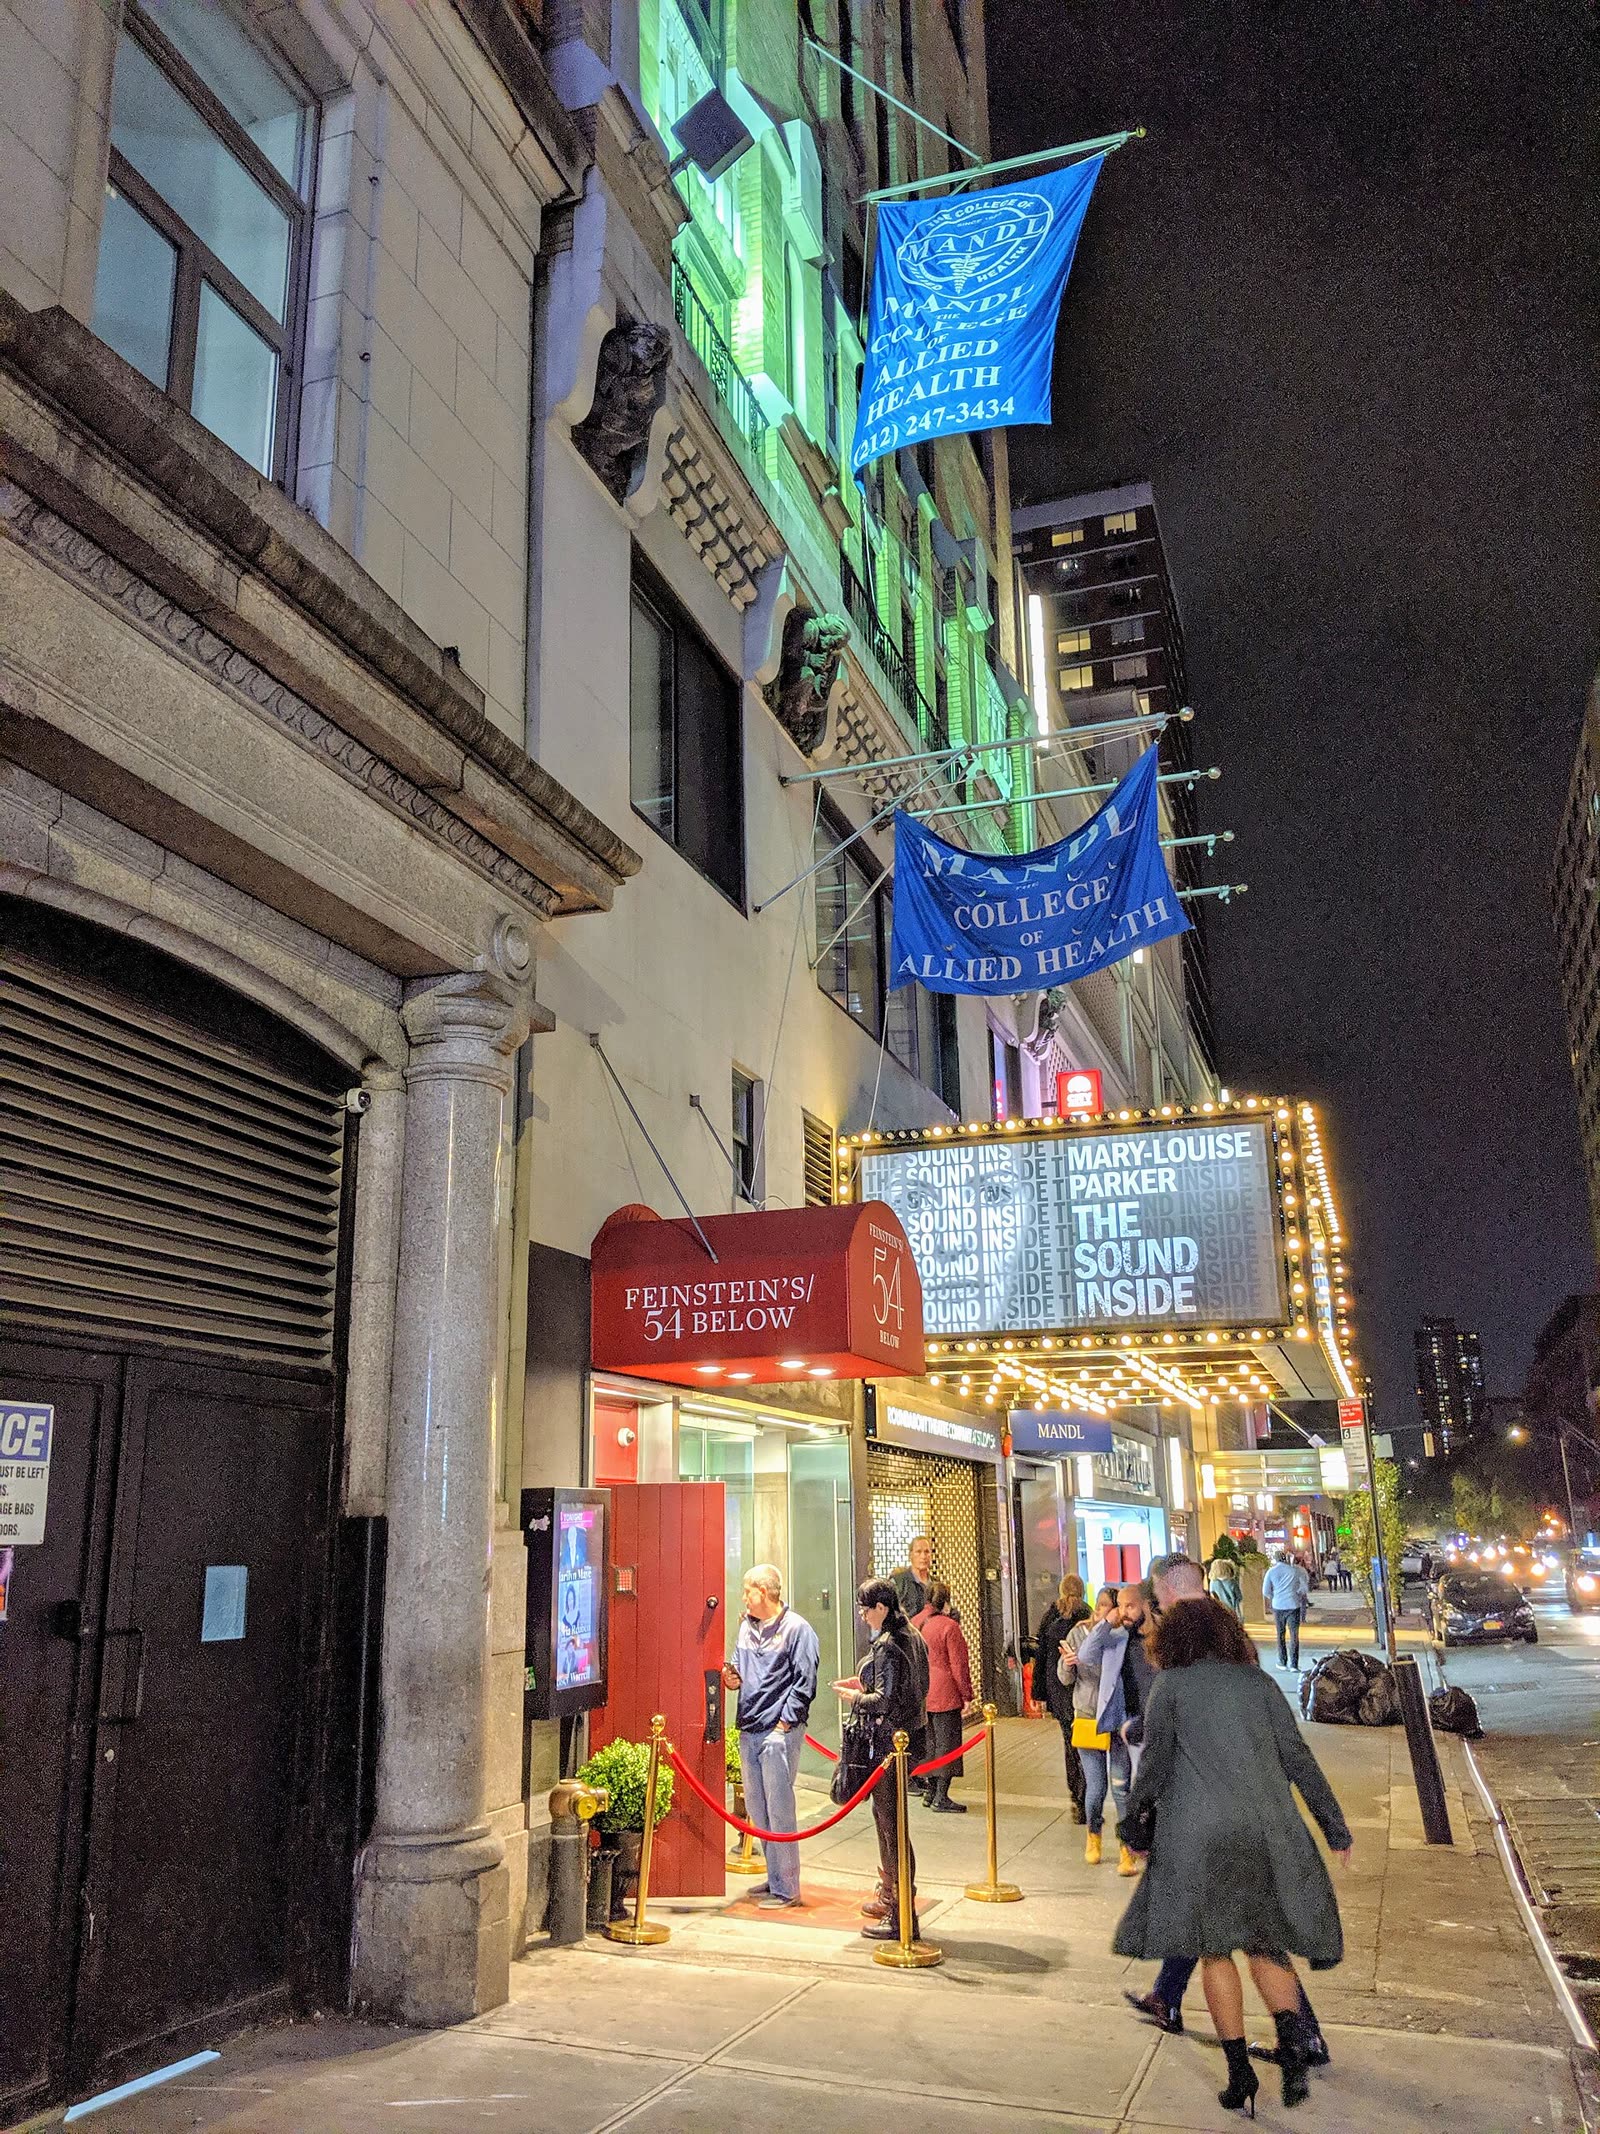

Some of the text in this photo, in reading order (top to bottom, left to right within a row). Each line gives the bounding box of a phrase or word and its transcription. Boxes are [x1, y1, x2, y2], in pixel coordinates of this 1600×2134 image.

[926, 199, 1034, 228] THE COLLEGE OF
[908, 218, 1045, 262] MANDL
[908, 266, 943, 291] ALLIED
[977, 245, 1028, 283] HEALTH
[880, 282, 1035, 321] MANDL
[935, 313, 960, 321] THE
[871, 303, 1028, 354] COLLEGE
[927, 333, 949, 350] OF
[875, 338, 999, 393] ALLIED
[864, 365, 1002, 428] HEALTH
[853, 396, 1015, 468] (212) 247-3434
[920, 804, 1139, 885] MANDL
[953, 875, 1111, 931] COLLEGE
[897, 896, 1172, 982] ALLIED HEALTH
[1019, 930, 1043, 947] OF
[1067, 1131, 1252, 1171] MARY-LOUISE
[906, 1164, 975, 1188] SOUND
[1070, 1167, 1178, 1199] PARKER
[907, 1208, 977, 1233] SOUND
[1072, 1201, 1141, 1240] THE
[909, 1231, 978, 1256] SOUND
[1074, 1236, 1199, 1279] SOUND
[625, 1273, 815, 1310] FEINSTEIN'S/
[872, 1247, 904, 1330] 54
[923, 1278, 980, 1300] OUND
[1076, 1276, 1197, 1318] INSIDE
[643, 1306, 795, 1341] 54 BELOW
[924, 1300, 981, 1323] OUND
[880, 1330, 900, 1348] BELOW
[1037, 1423, 1085, 1441] MANDL
[1344, 1429, 1350, 1439] 6
[0, 1466, 45, 1479] UST BE LEFT
[15, 1503, 34, 1515] BAGS
